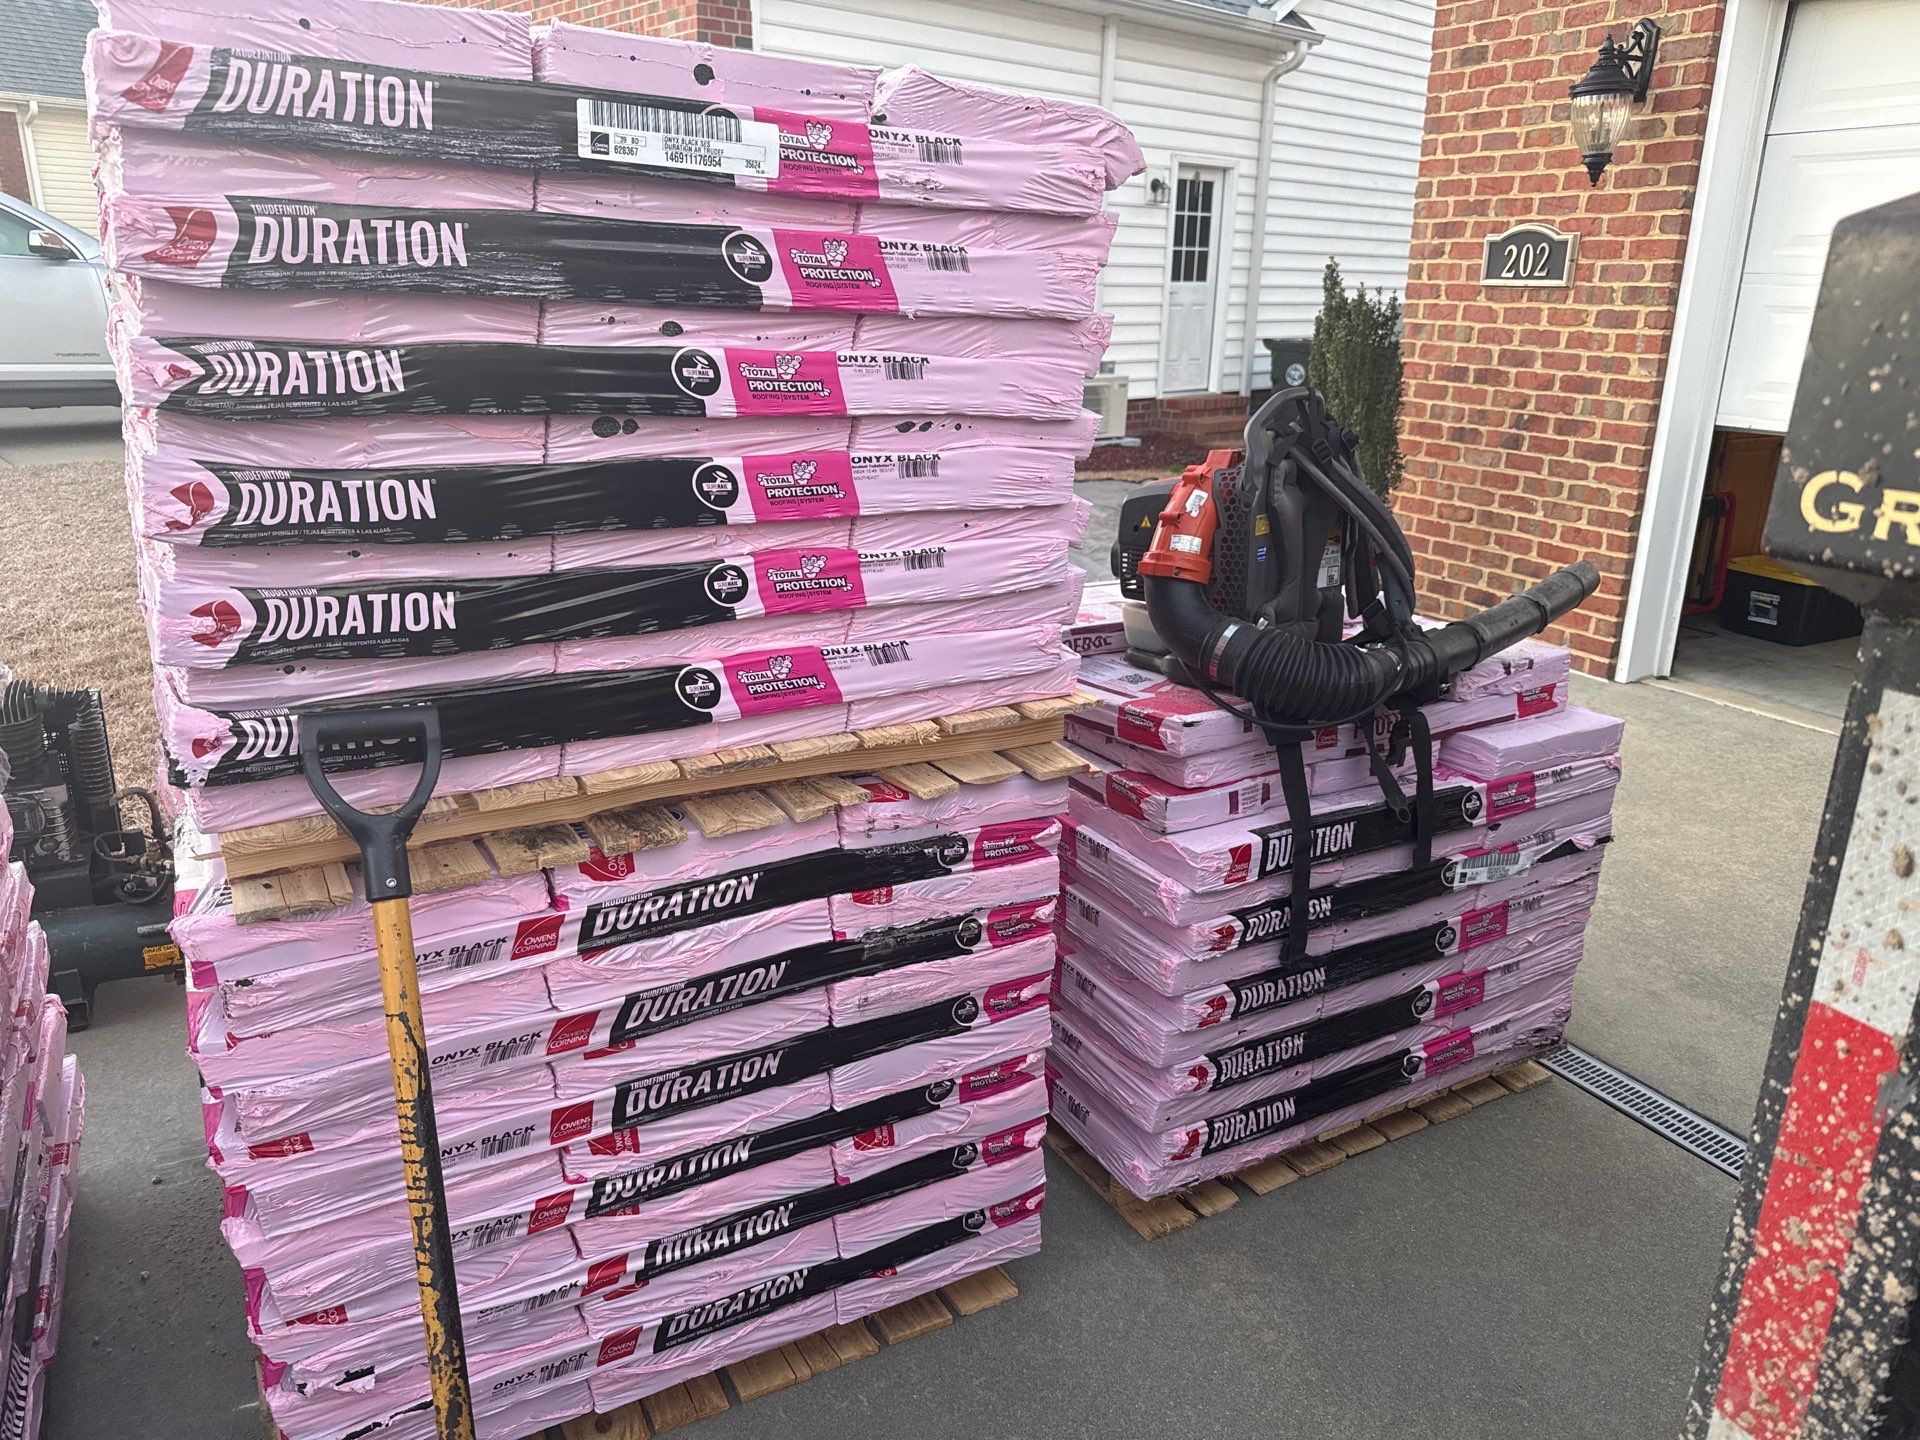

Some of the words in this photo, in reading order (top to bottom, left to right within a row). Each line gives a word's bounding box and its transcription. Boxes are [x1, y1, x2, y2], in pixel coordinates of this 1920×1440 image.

[681, 138, 699, 147] BLACK
[779, 134, 808, 147] TOTAL
[869, 129, 912, 142] ONYX
[915, 135, 962, 146] BLACK
[614, 145, 639, 156] 628367
[664, 143, 693, 153] DURATION
[780, 149, 856, 168] PROTECTION
[250, 204, 317, 216] TRUDEFINITION
[247, 216, 468, 267] DURATION
[879, 241, 919, 252] ONYX
[922, 243, 968, 255] BLACK
[798, 255, 825, 264] TOTAL
[1500, 242, 1550, 278] 202
[801, 268, 873, 281] PROTECTION
[806, 281, 834, 289] ROOFING
[191, 340, 256, 354] TRUDEFINITION
[837, 354, 879, 363] ONYX
[882, 355, 930, 364] BLACK
[198, 349, 406, 396] DURATION
[746, 368, 776, 378] TOTAL
[749, 381, 823, 393] PROTECTION
[752, 393, 780, 401] ROOFING
[851, 455, 893, 465] ONYX
[897, 453, 941, 462] BLACK
[230, 470, 291, 481] TRUDEFINITION
[764, 476, 791, 485] TOTAL
[767, 485, 838, 498] PROTECTION
[231, 479, 437, 527] DURATION
[770, 499, 797, 507] ROOFING
[800, 497, 824, 505] SYSTEM
[1800, 469, 1920, 548] GR
[858, 551, 900, 560] ONYX
[902, 546, 947, 557] BLACK
[773, 571, 801, 579] TOTAL
[776, 578, 846, 591] PROTECTION
[257, 588, 318, 598] TRUDEFINITION
[778, 591, 807, 599] ROOFING
[257, 591, 457, 644] DURATION
[821, 646, 860, 657] ONYX
[863, 640, 910, 652] BLACK
[744, 671, 771, 681] TOTAL
[748, 676, 818, 694] PROTECTION
[753, 693, 782, 701] ROOFING
[784, 689, 807, 698] SYSTEM
[229, 707, 291, 720] TRUDEFINITION
[1531, 771, 1550, 780] ONYX
[1552, 765, 1574, 776] BLACK
[985, 844, 1030, 859] PROTECTION
[1088, 839, 1111, 854] BLACK
[1265, 821, 1355, 873] DUTION
[592, 872, 759, 937] DURATION
[601, 892, 653, 908] TRUDEFINITION
[1078, 897, 1101, 917] BLACK
[1503, 901, 1522, 911] ONYX
[1523, 894, 1545, 905] BLACK
[1245, 895, 1332, 941] DURAON
[515, 940, 557, 954] CORNING
[524, 932, 557, 947] OWENS
[416, 949, 443, 963] NYX
[448, 936, 508, 956] BLACK
[1076, 968, 1097, 990] BLACK
[624, 961, 787, 1030] DURATION
[640, 981, 687, 1000] TRUDEFINITION
[1239, 966, 1327, 1012] DURATION
[550, 1034, 588, 1049] CORNING
[1062, 1026, 1083, 1047] BLACK
[431, 1045, 481, 1065] ONYX
[485, 1031, 542, 1052] BLACK
[1433, 1047, 1466, 1063] PROTECTION
[1219, 1032, 1305, 1083] DURATION
[624, 1049, 785, 1118] DURATION
[630, 1070, 682, 1090] TRUDEFINITION
[1068, 1095, 1092, 1117] BLACK
[560, 1116, 591, 1131] OWENS
[1209, 1096, 1296, 1149] DURATION
[440, 1141, 477, 1157] NYX
[481, 1123, 537, 1146] BLACK
[600, 1137, 756, 1206] DURATION
[539, 1204, 569, 1220] OWENS
[450, 1228, 470, 1240] YX
[473, 1213, 524, 1234] BLACK
[666, 1267, 809, 1338] DURATION
[493, 1370, 536, 1391] ONYX
[540, 1351, 589, 1373] BLACK
